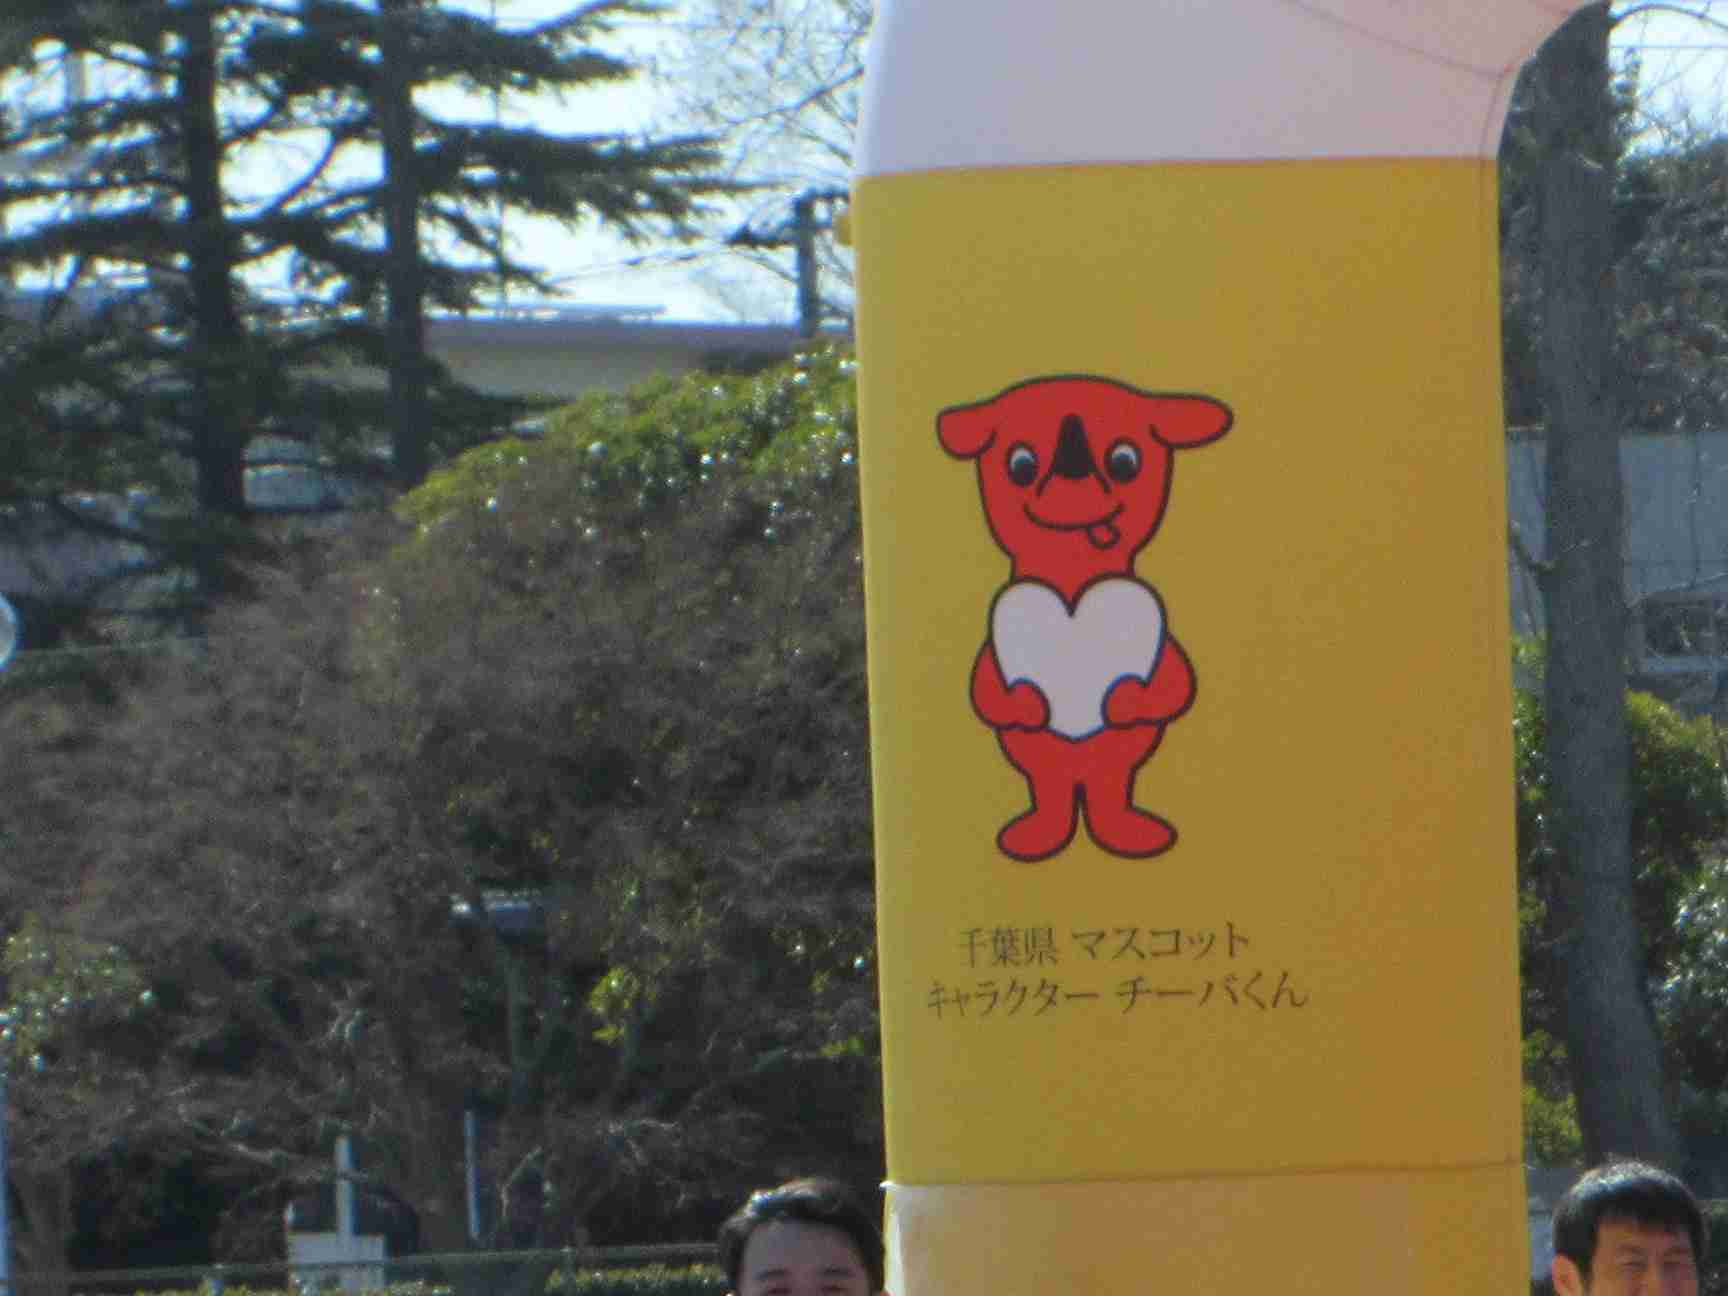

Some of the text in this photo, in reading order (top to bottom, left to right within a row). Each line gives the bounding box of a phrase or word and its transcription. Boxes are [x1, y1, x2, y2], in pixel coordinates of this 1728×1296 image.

[959, 921, 1250, 967] 千葉県 マスコット
[928, 970, 1309, 1018] キャラクター チーバくん
